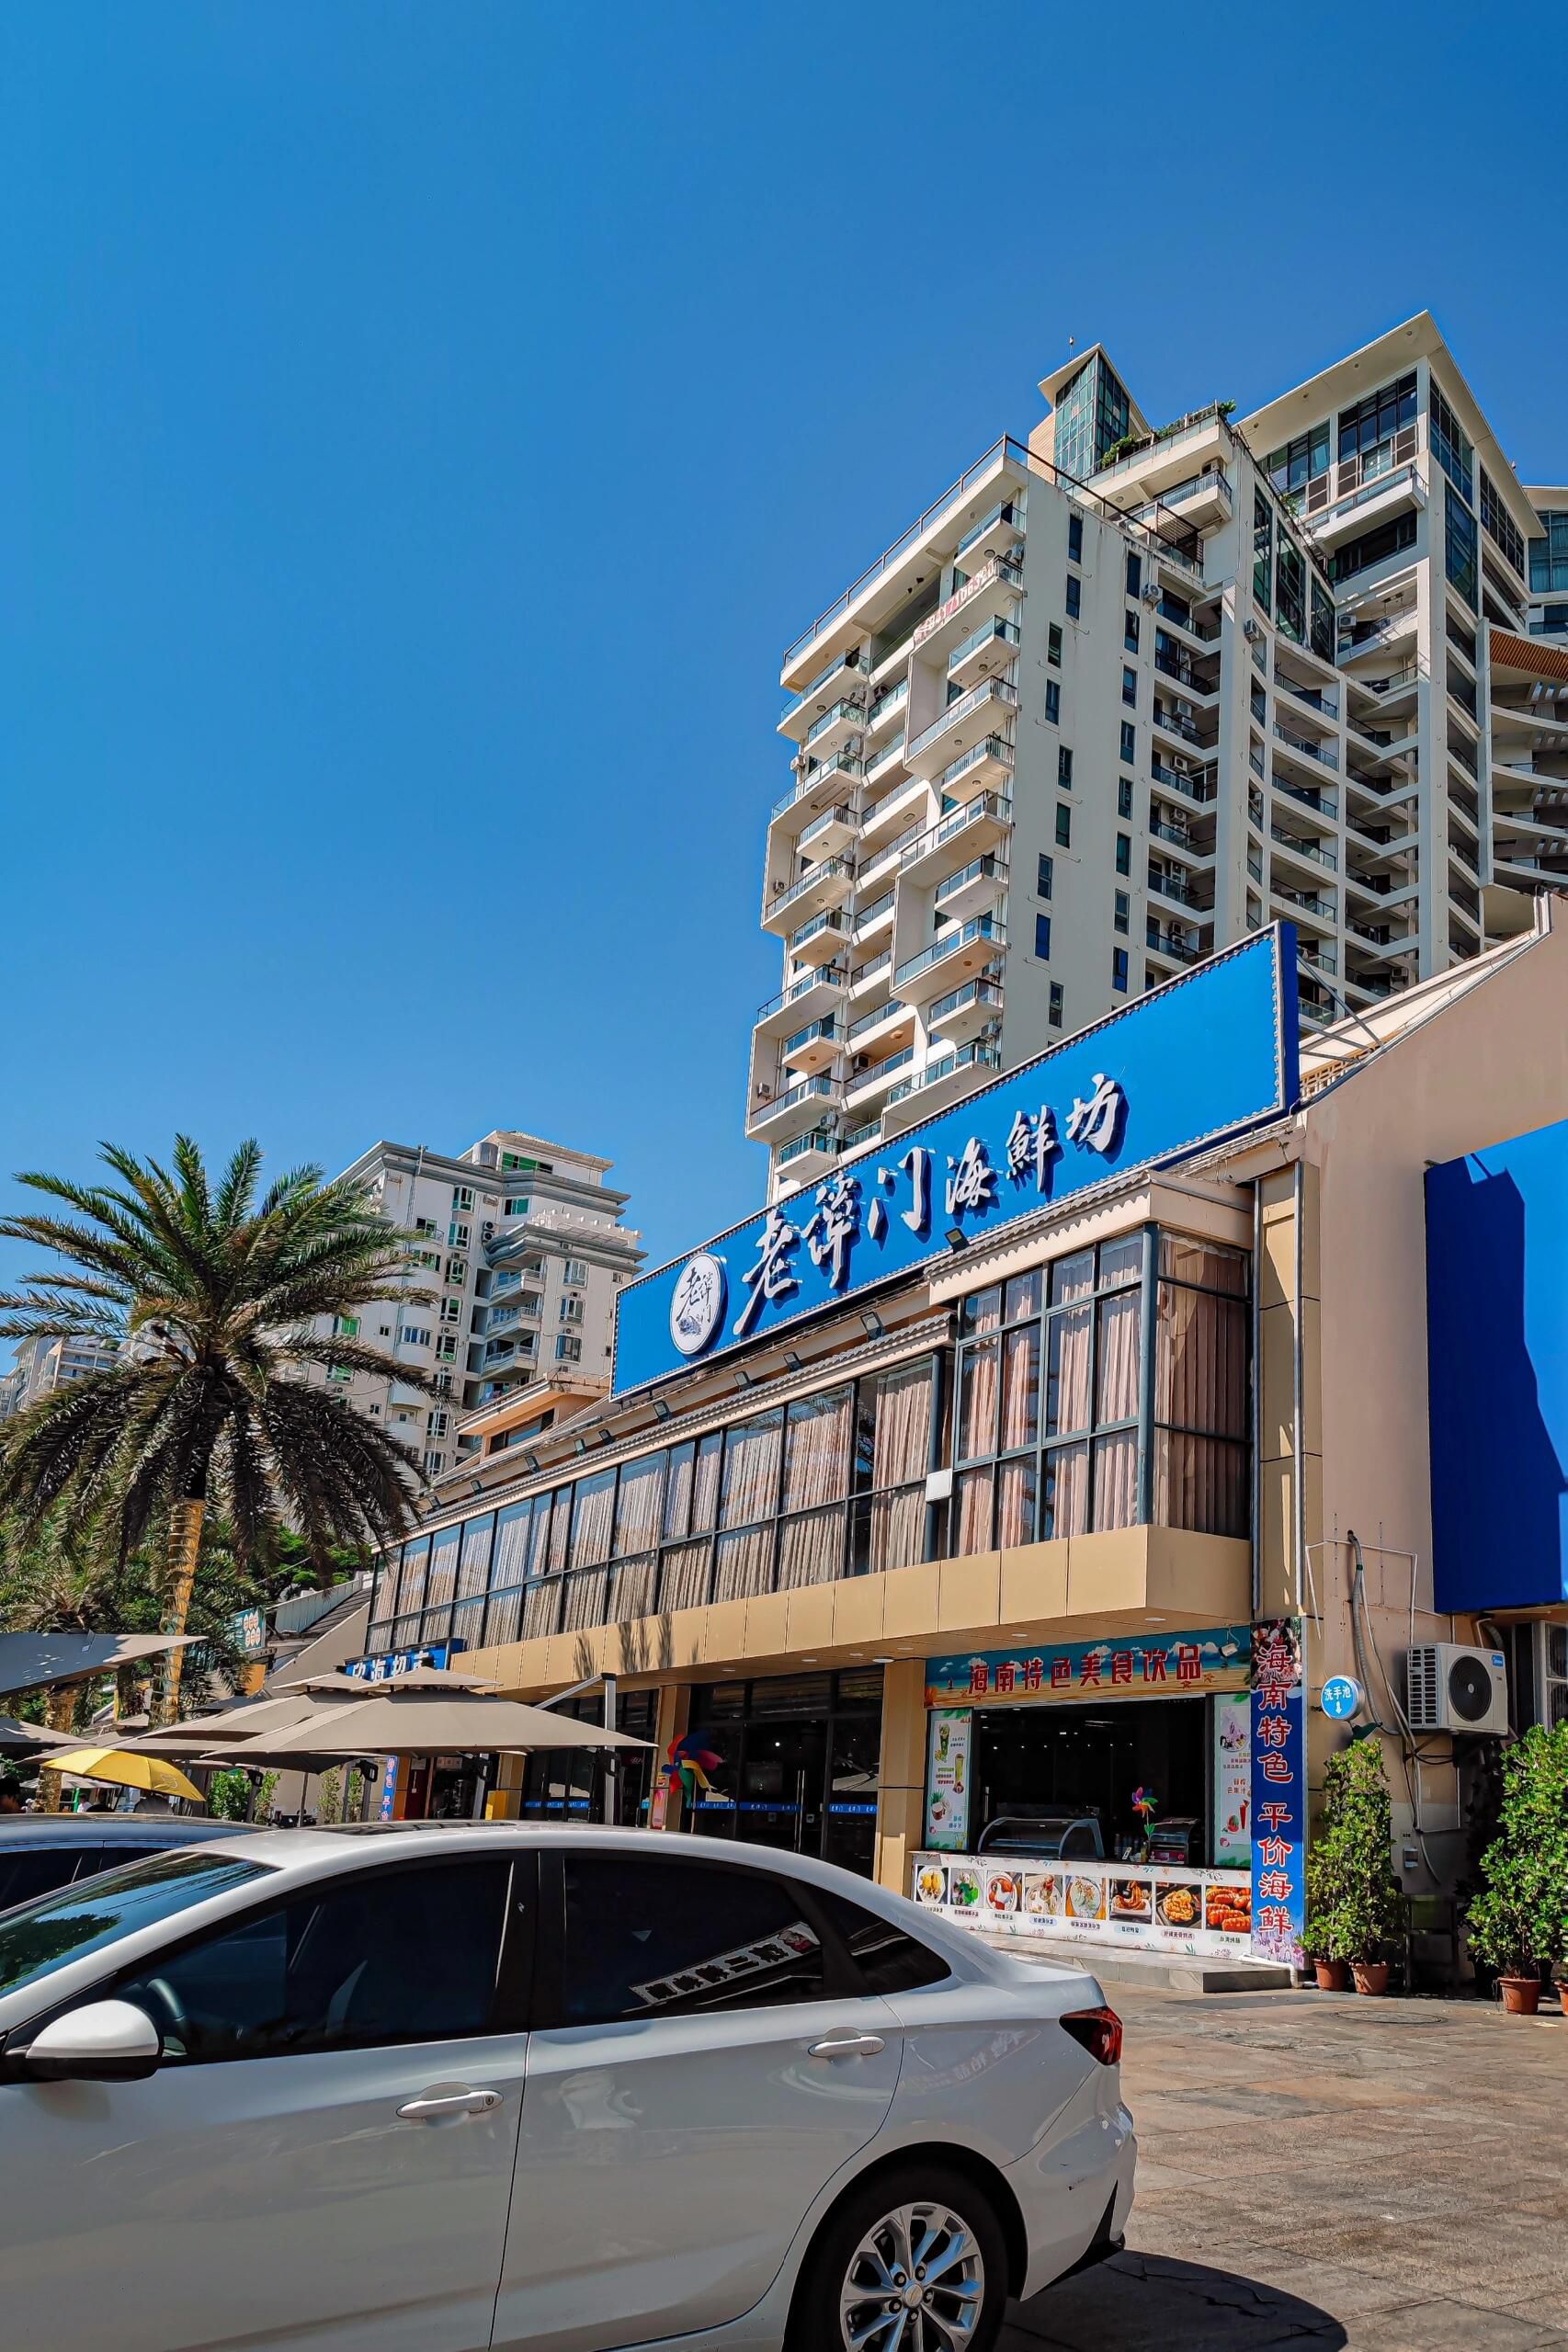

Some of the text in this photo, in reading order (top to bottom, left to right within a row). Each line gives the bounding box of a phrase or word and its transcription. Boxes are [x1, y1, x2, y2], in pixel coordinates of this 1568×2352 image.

[968, 1645, 1202, 1694] 海南特色美食饮品
[1324, 1685, 1351, 1701] 洗手池
